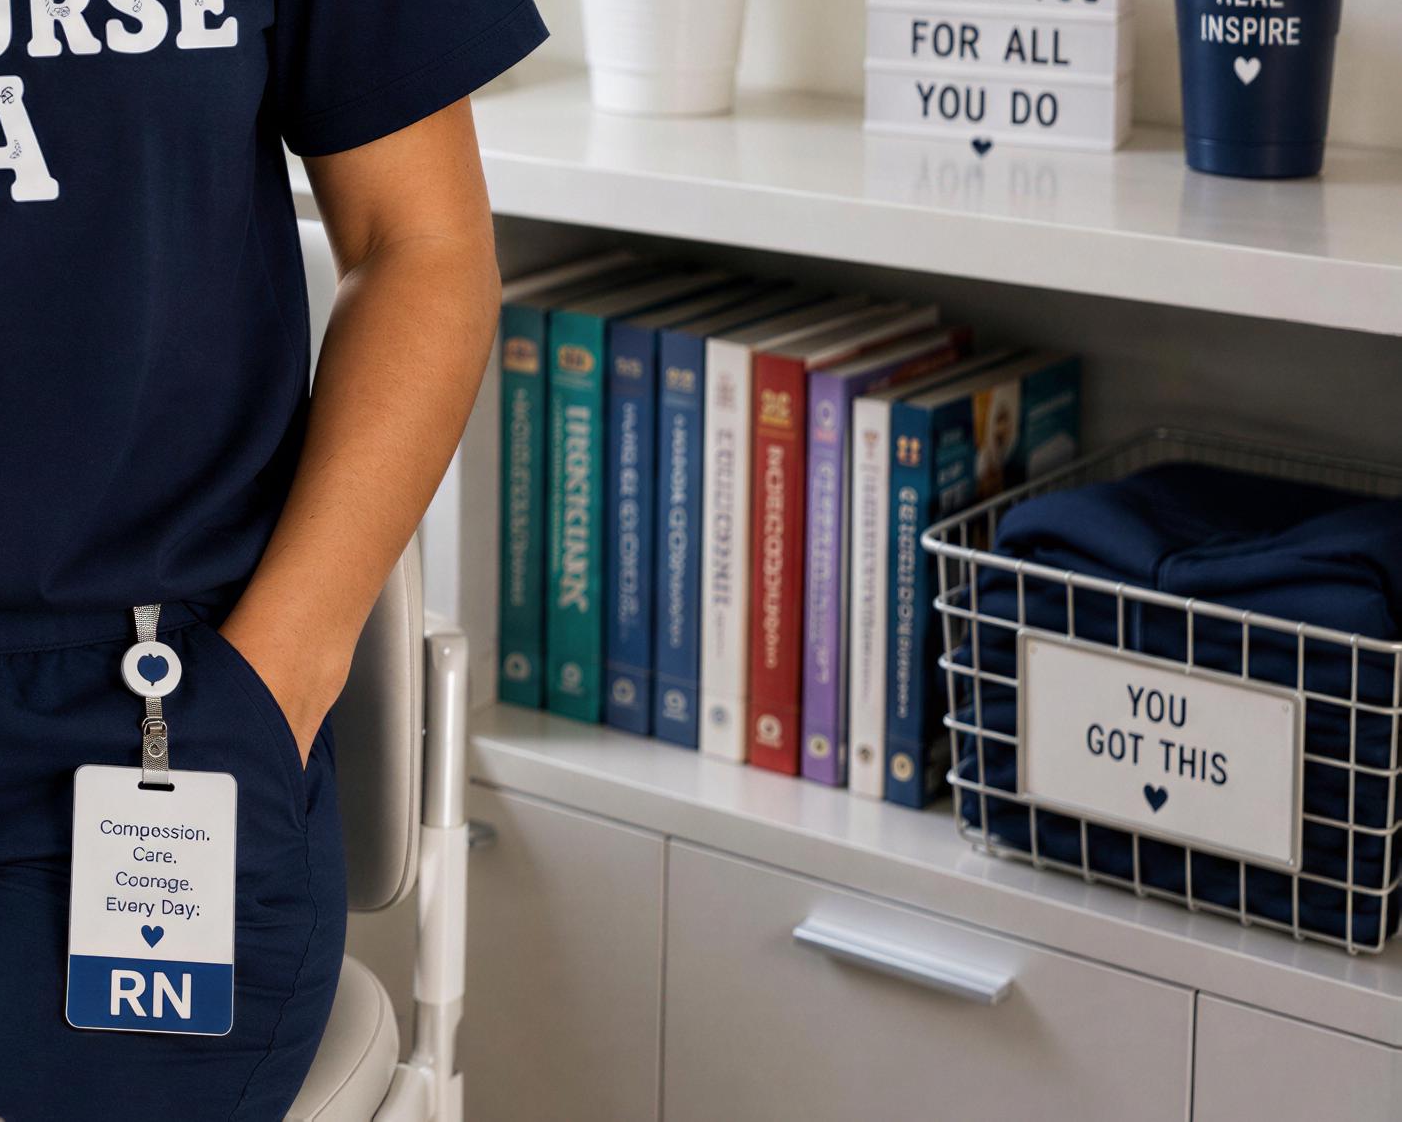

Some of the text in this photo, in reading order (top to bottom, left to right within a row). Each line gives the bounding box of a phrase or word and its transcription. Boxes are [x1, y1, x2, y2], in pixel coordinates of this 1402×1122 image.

[912, 21, 1069, 65] FOR ALL
[1200, 13, 1300, 46] INSPIRE
[917, 83, 1058, 127] YOU DO
[1127, 685, 1187, 728] YOU
[1087, 723, 1227, 786] GOT THIS
[132, 846, 178, 865] Care.
[106, 896, 156, 918] Every
[110, 969, 192, 1020] RN
